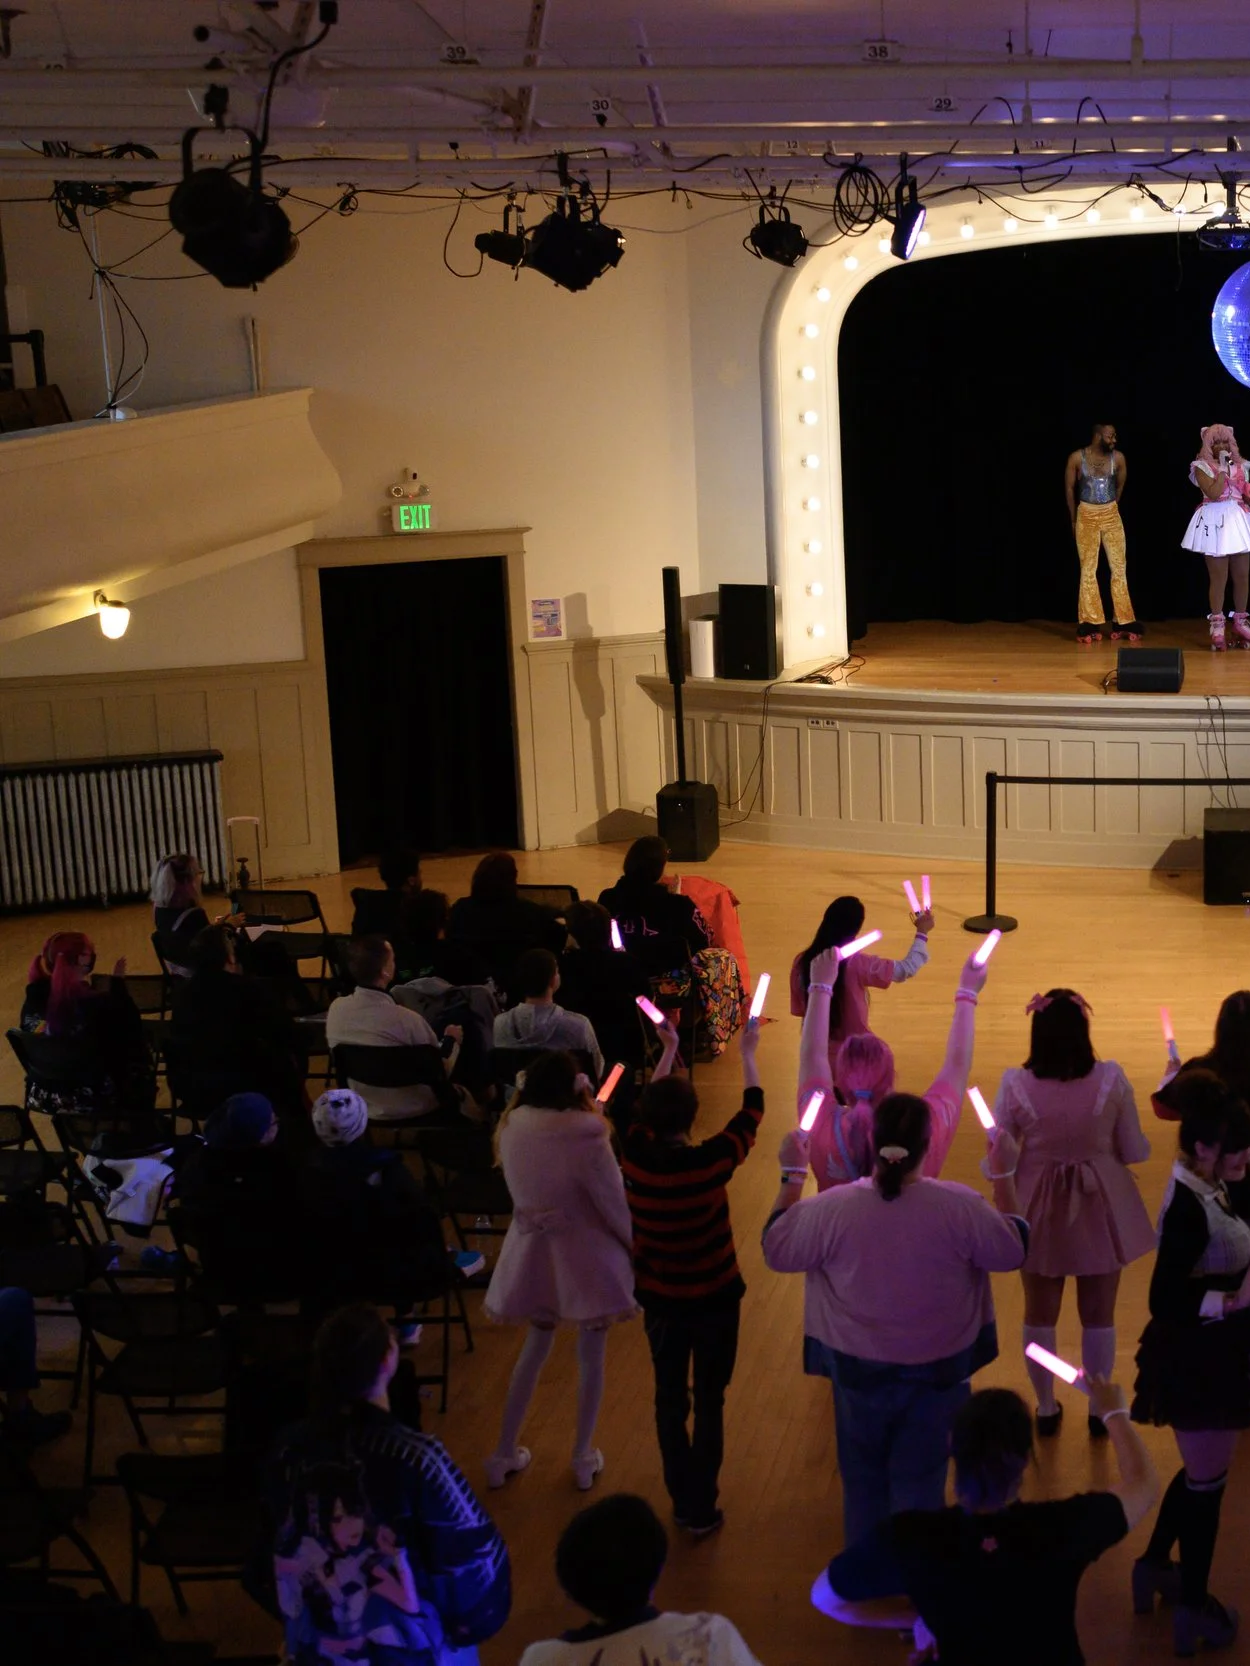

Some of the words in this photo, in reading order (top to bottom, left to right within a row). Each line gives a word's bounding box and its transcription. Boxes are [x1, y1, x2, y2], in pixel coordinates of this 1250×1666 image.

[446, 46, 467, 59] 39
[868, 46, 889, 58] 38
[592, 100, 609, 111] 30
[935, 98, 952, 109] 29
[787, 141, 798, 149] 12
[399, 504, 432, 530] EXIT
